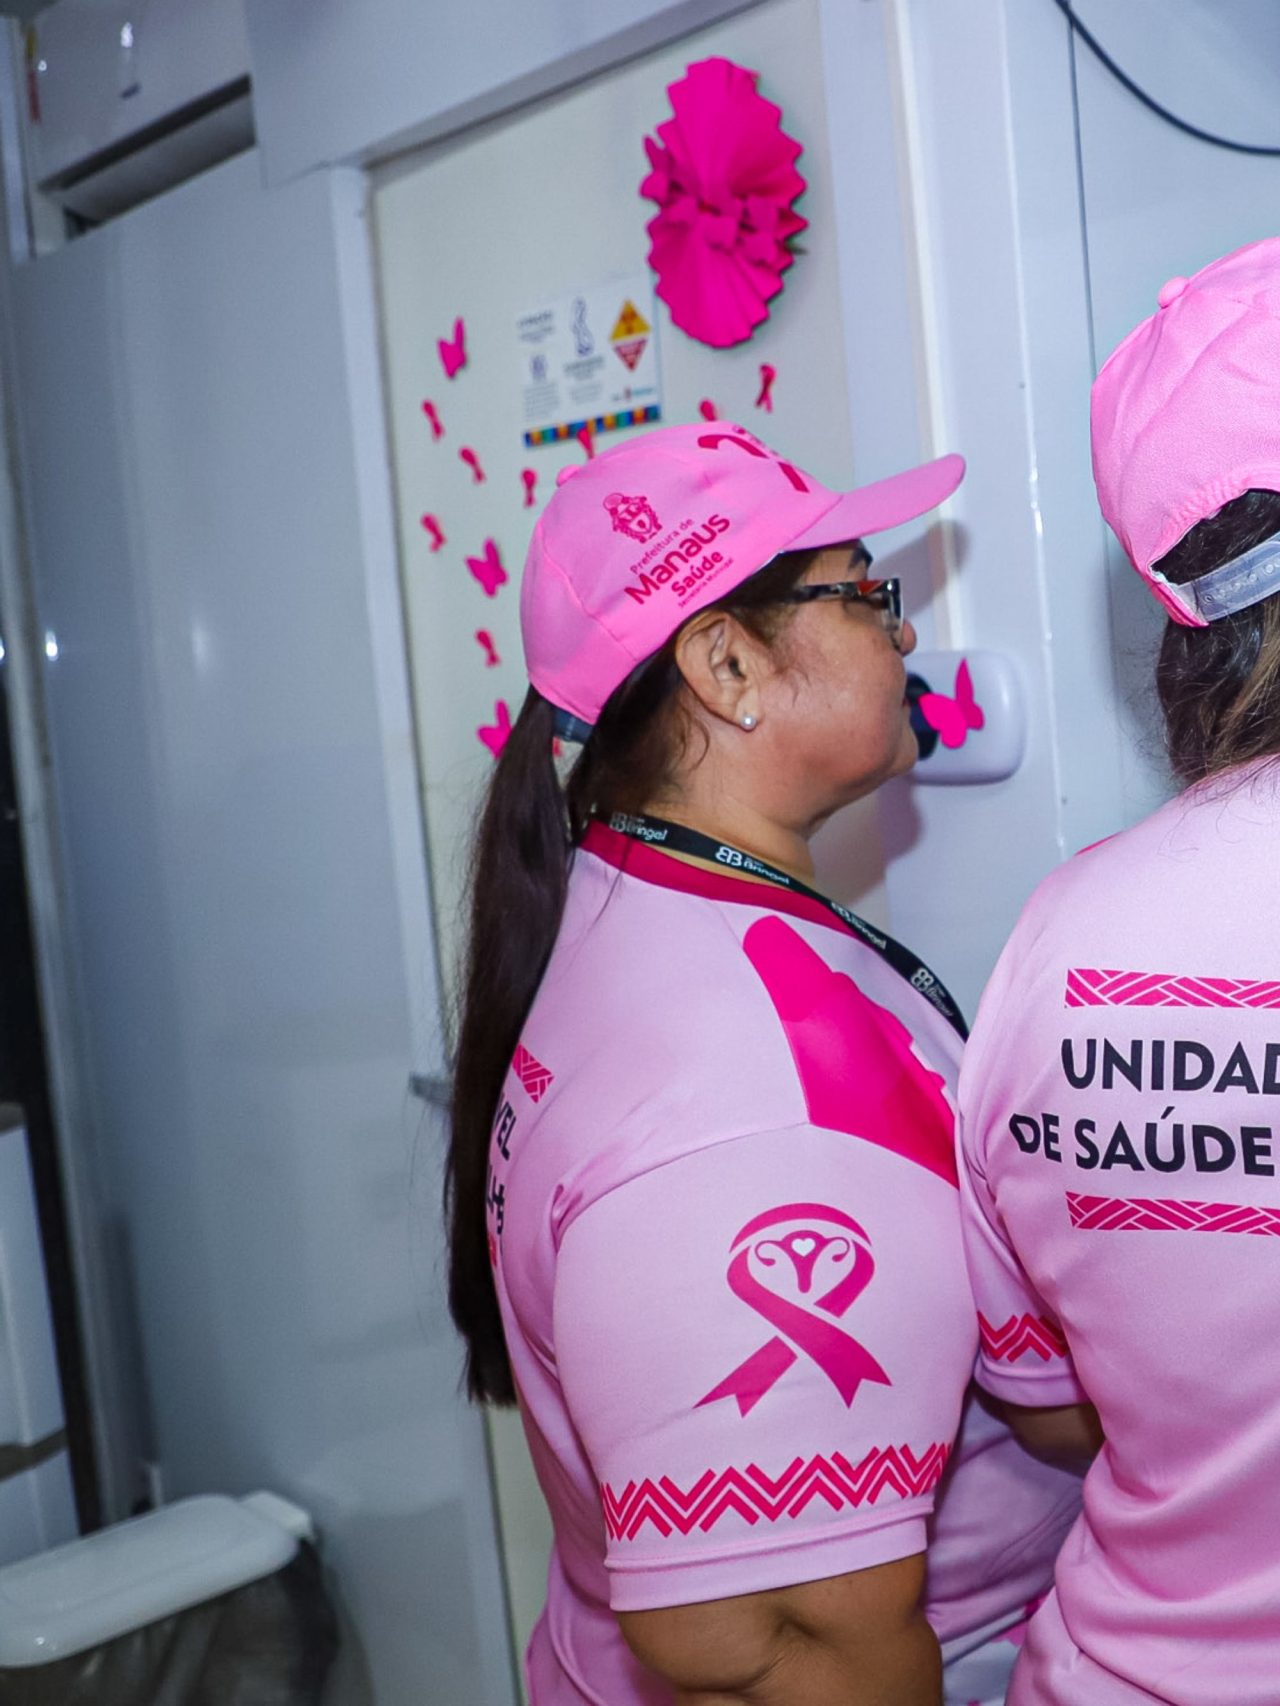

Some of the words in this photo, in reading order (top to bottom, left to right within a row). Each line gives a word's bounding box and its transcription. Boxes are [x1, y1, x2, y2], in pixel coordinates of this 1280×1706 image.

[624, 514, 730, 605] Manaus
[630, 530, 680, 574] Prefeitura
[680, 519, 694, 531] de
[671, 551, 723, 597] Saúde
[1009, 1112, 1062, 1163] DE
[1074, 1106, 1275, 1177] SAÚDE
